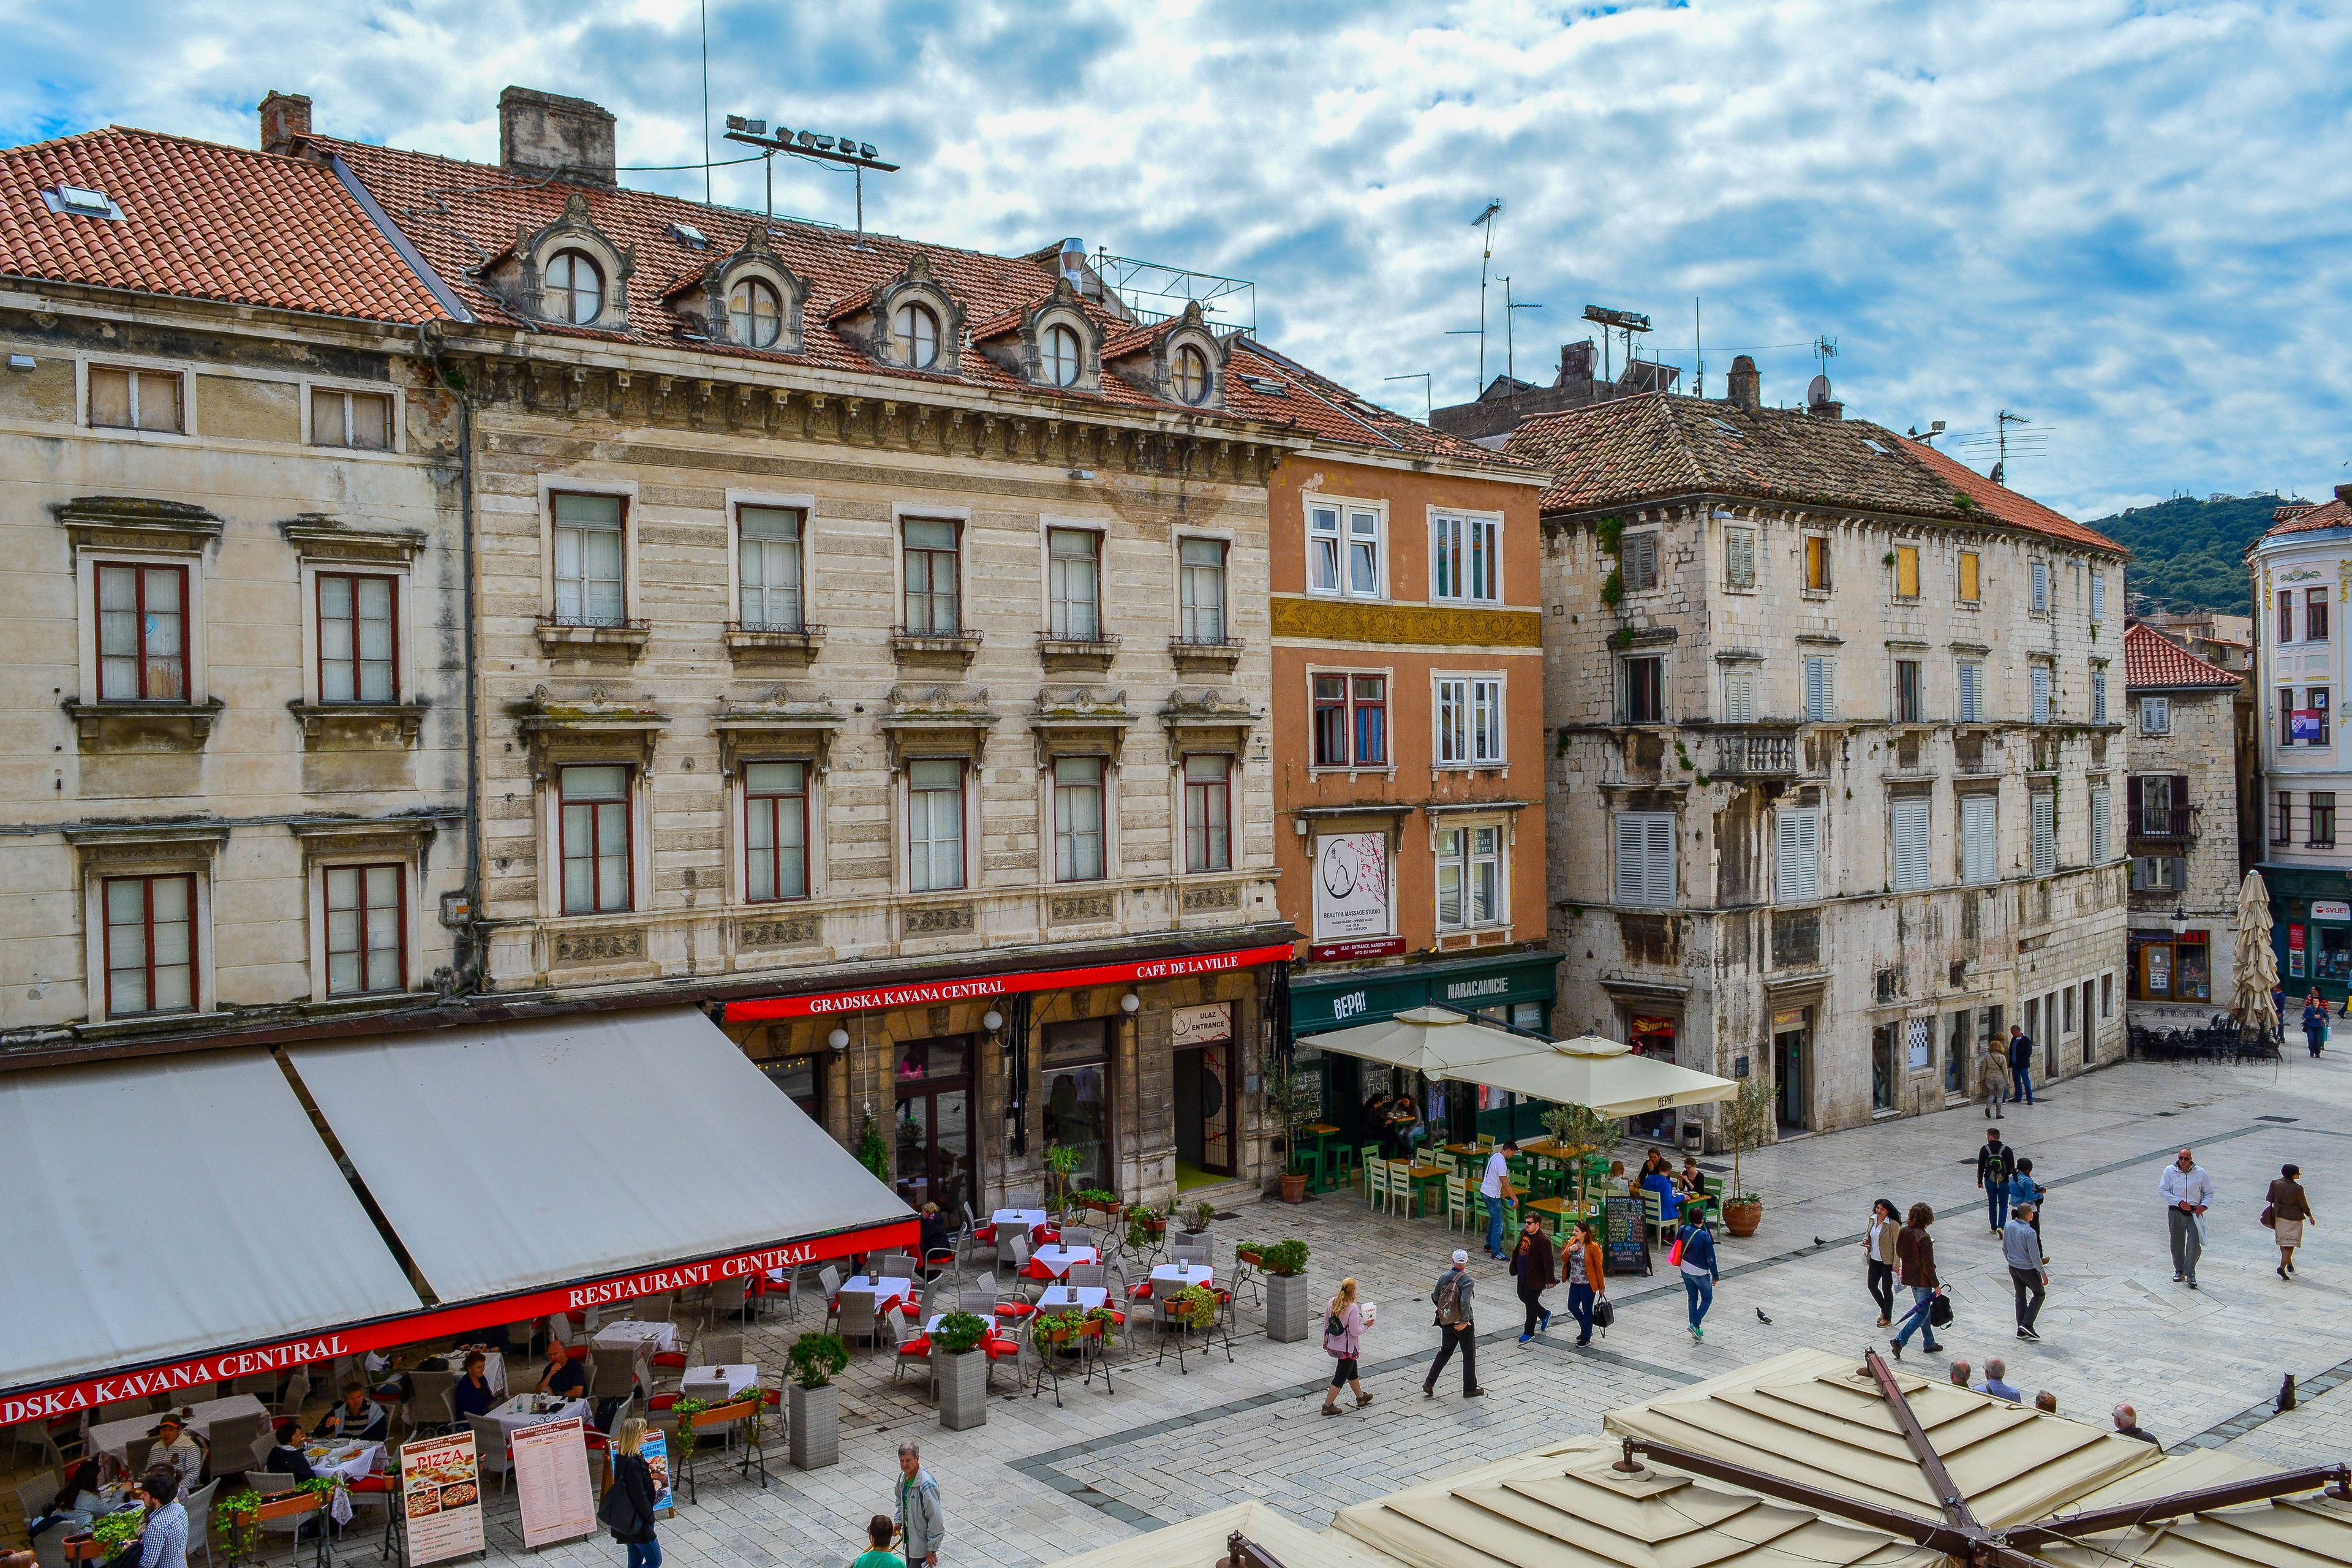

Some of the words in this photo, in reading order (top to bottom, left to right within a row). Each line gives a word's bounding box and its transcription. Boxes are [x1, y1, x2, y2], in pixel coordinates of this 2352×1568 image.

[1170, 962, 1186, 974] DE
[1188, 960, 1204, 972] LA
[1205, 956, 1238, 970] VILLE
[810, 994, 881, 1012] GRADSKA
[884, 988, 940, 1005] KAVANA
[942, 981, 1006, 998] CENTRAL
[1192, 1020, 1224, 1031] ENTRANCE
[1305, 1072, 1321, 1083] cook
[1365, 1068, 1390, 1080] yummy
[1368, 1077, 1390, 1097] fish
[569, 1264, 712, 1308] RESTAURANT
[722, 1245, 816, 1277] CENTRAL
[0, 1388, 89, 1424] DSKA
[94, 1363, 213, 1404] KAVANA
[217, 1336, 348, 1377] CENTRAL
[516, 1425, 552, 1436] RESTAURANT
[405, 1439, 444, 1450] RESTAURANT
[425, 1442, 453, 1450] CENTRAL
[416, 1449, 466, 1471] PIZZA
